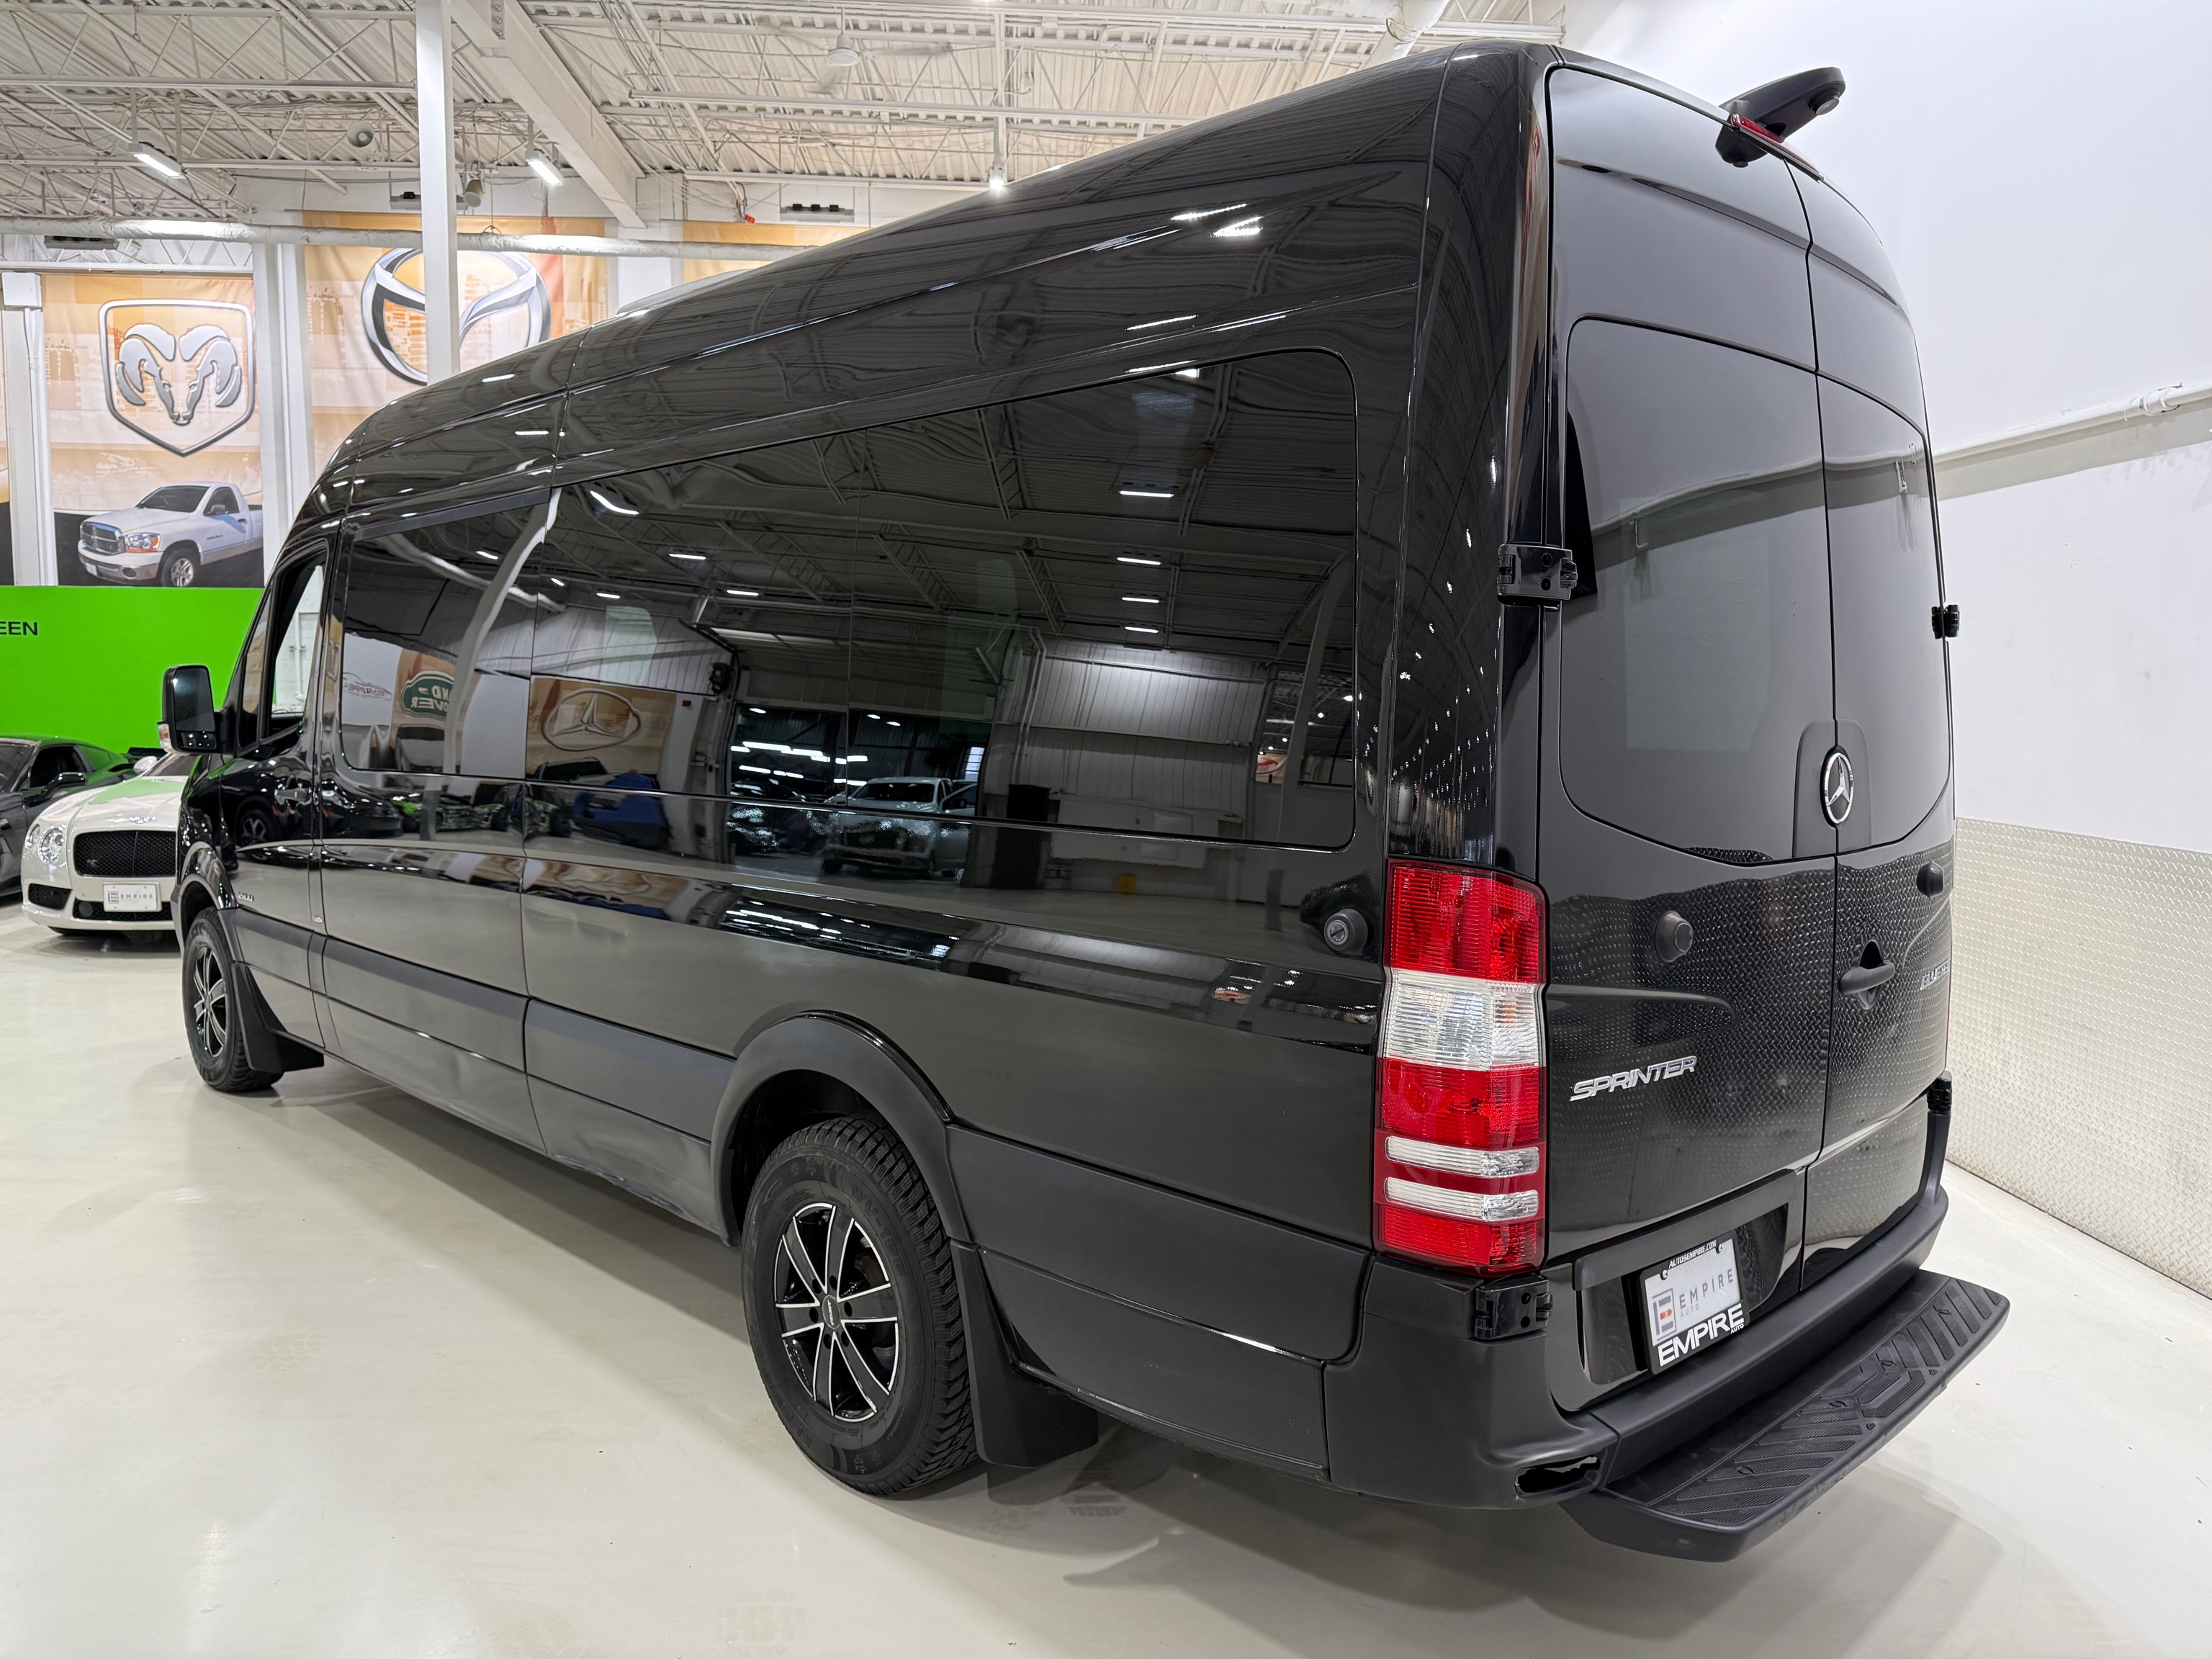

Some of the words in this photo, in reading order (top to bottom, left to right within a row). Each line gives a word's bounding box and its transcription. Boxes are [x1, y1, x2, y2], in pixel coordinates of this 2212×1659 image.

[1570, 1055, 1698, 1102] SPRINTER
[1668, 1239, 1717, 1269] AUTOSEMPIRE.COM
[1678, 1268, 1734, 1310] EMPIRE
[1680, 1304, 1699, 1318] AUTO
[1730, 1323, 1745, 1334] AUTO
[1658, 1303, 1745, 1367] EMPIRE
